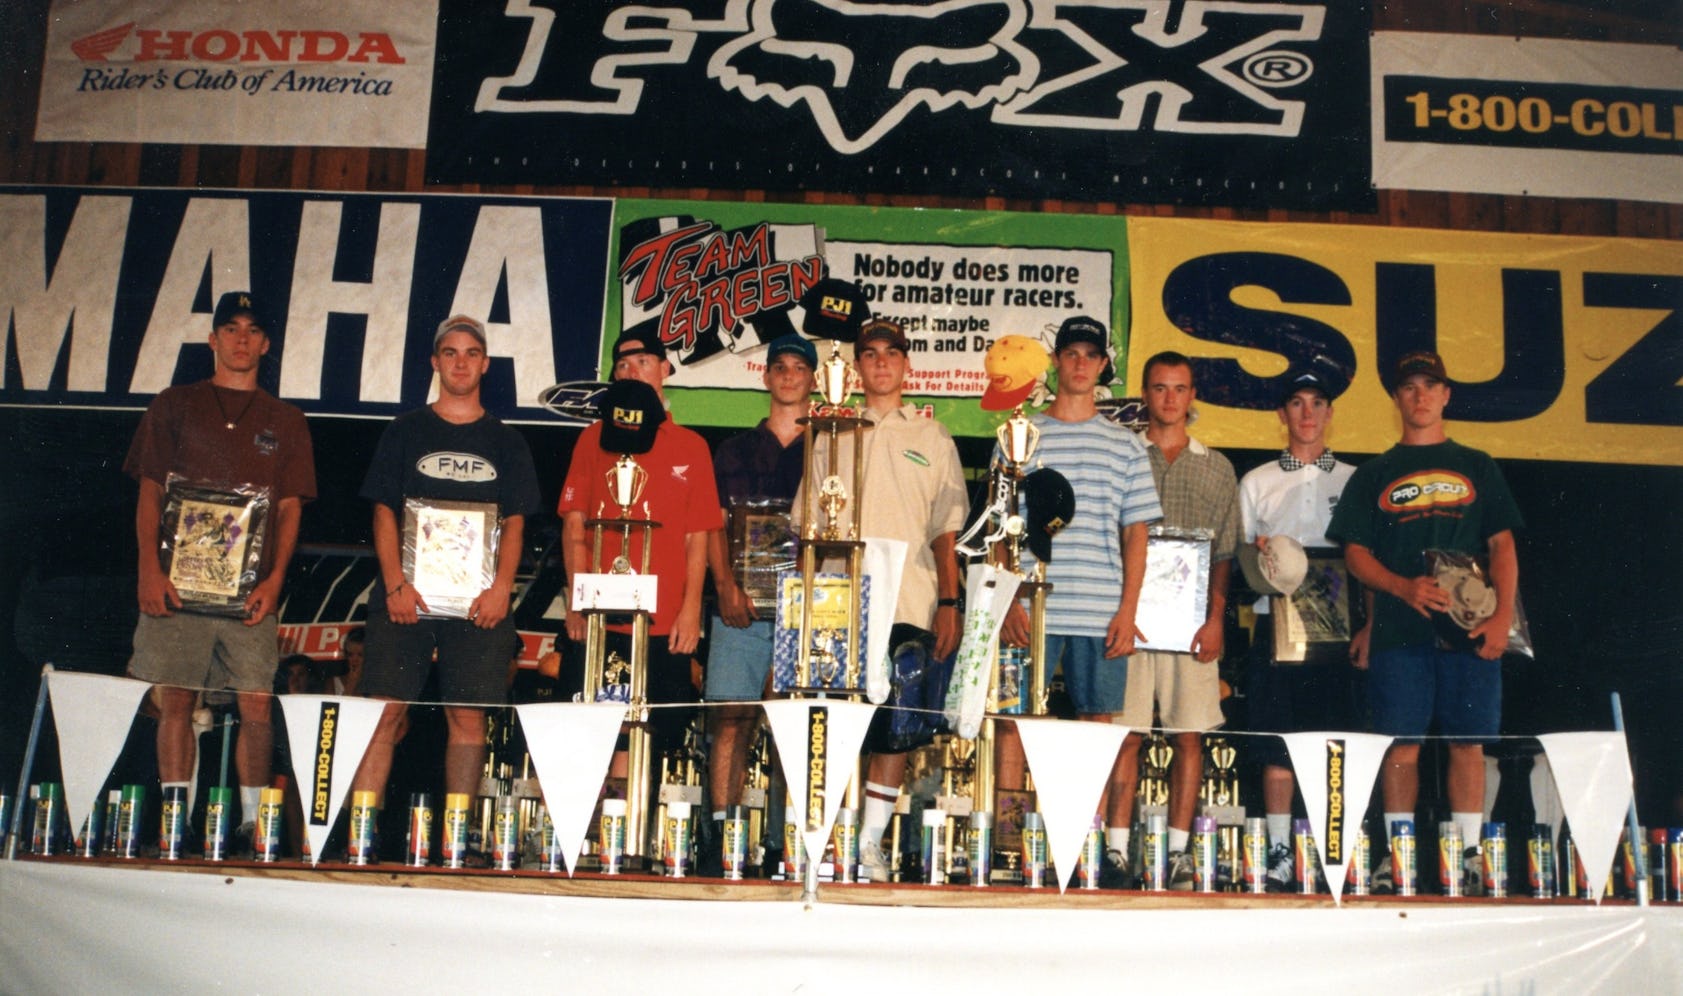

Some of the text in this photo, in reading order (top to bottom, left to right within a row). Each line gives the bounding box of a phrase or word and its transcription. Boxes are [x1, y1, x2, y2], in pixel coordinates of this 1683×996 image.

[134, 30, 406, 64] HONDA
[77, 68, 393, 96] Rider's Club of America
[618, 221, 769, 307] TEAM
[853, 253, 1080, 284] Nobody does more
[657, 255, 823, 351] GREEN
[820, 296, 853, 316] PJ1
[893, 282, 1000, 306] amateur
[1003, 287, 1084, 309] racers.
[931, 316, 990, 334] maybe
[904, 335, 995, 352] om and Da
[908, 368, 951, 379] Support
[955, 368, 988, 380] Progr
[925, 381, 942, 391] For
[946, 382, 985, 392] Details
[613, 406, 643, 425] PJ1
[438, 457, 485, 474] FMF
[1391, 485, 1420, 502] PRO
[314, 707, 336, 821] 1-800-COLLECT
[808, 711, 825, 827] 1-800-COLLECT
[1328, 745, 1343, 861] 1-800-COLLECT
